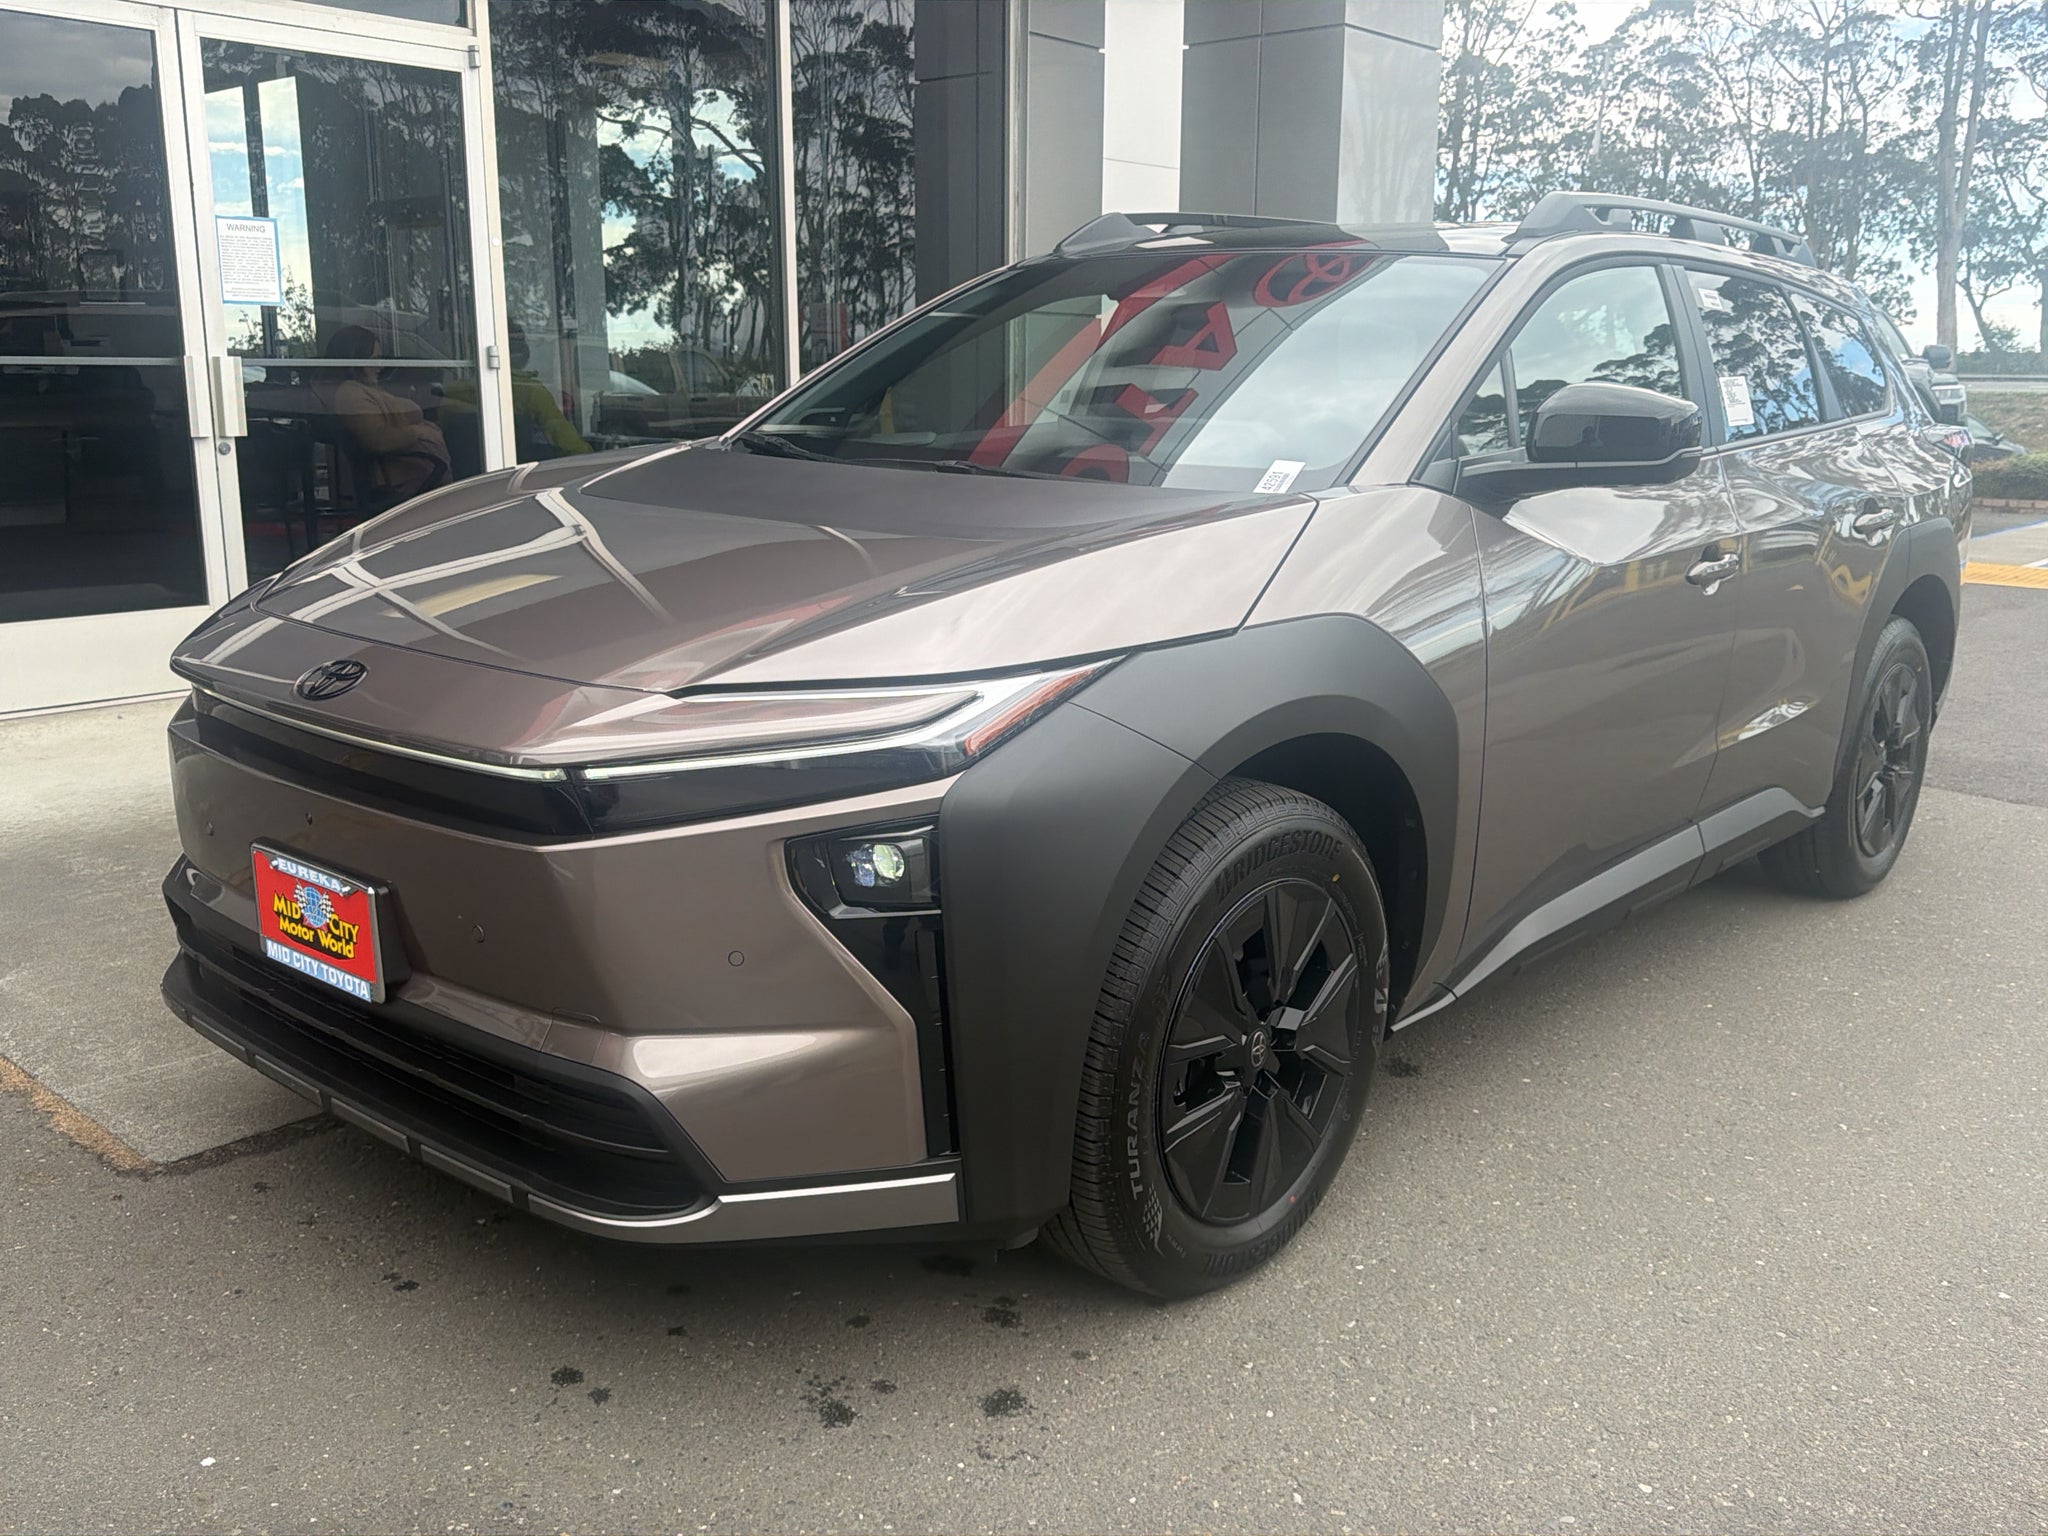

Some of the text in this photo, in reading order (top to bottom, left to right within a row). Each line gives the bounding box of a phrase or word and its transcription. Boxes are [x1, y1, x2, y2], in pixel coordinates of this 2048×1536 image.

[226, 223, 266, 233] WARNING
[277, 858, 341, 890] EUREKA
[1214, 829, 1344, 903] BRIDGESTONE
[273, 893, 360, 942] MID CITY
[279, 916, 355, 958] Motor World
[267, 940, 369, 998] MID CITY TOYOTA
[1127, 1032, 1150, 1199] TURANZA
